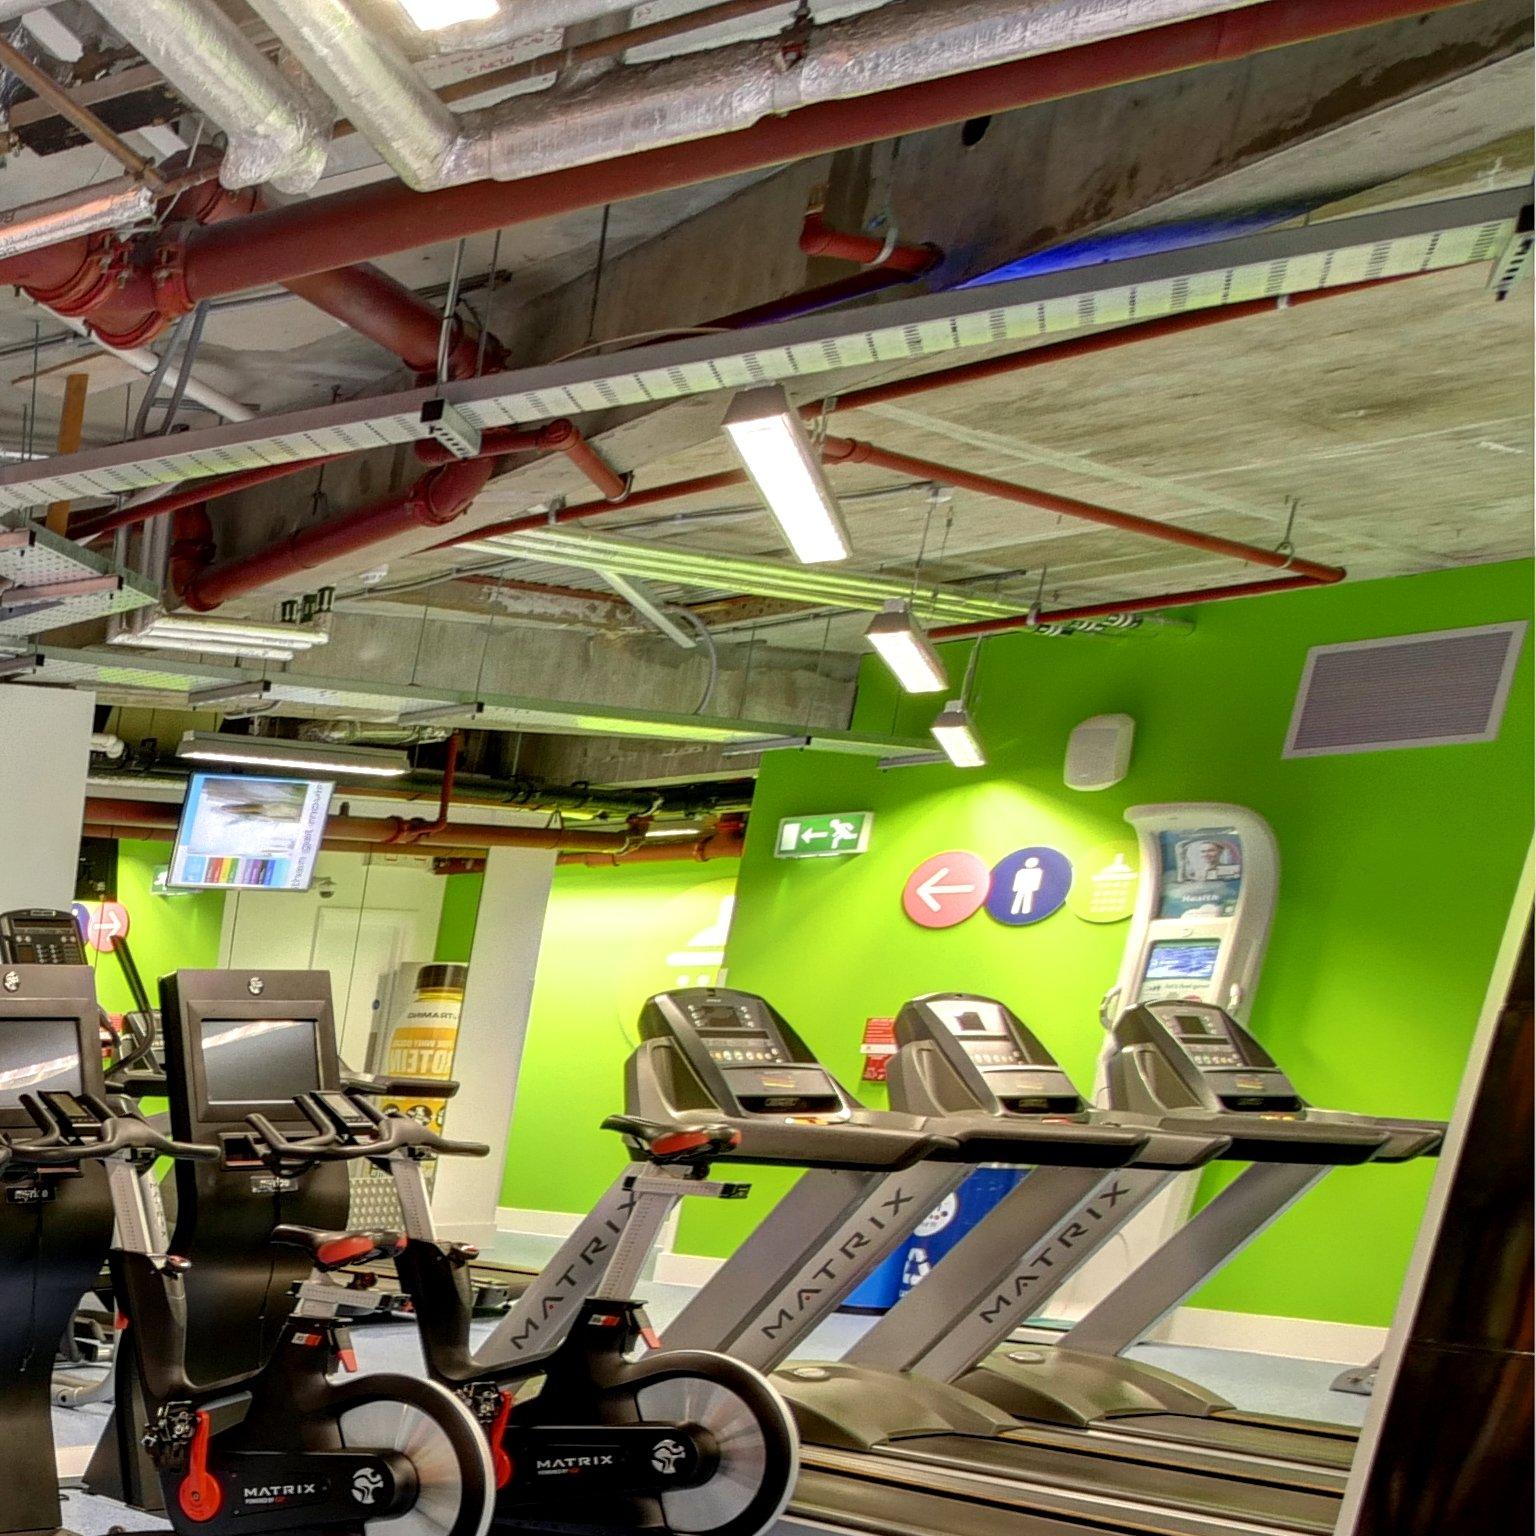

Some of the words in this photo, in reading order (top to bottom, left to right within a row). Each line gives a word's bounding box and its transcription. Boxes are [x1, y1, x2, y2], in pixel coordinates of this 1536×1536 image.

[761, 1187, 914, 1339] MATRIX
[979, 1181, 1131, 1324] MATRIX
[244, 1483, 316, 1498] MATRIX
[536, 1454, 614, 1469] MATRIX
